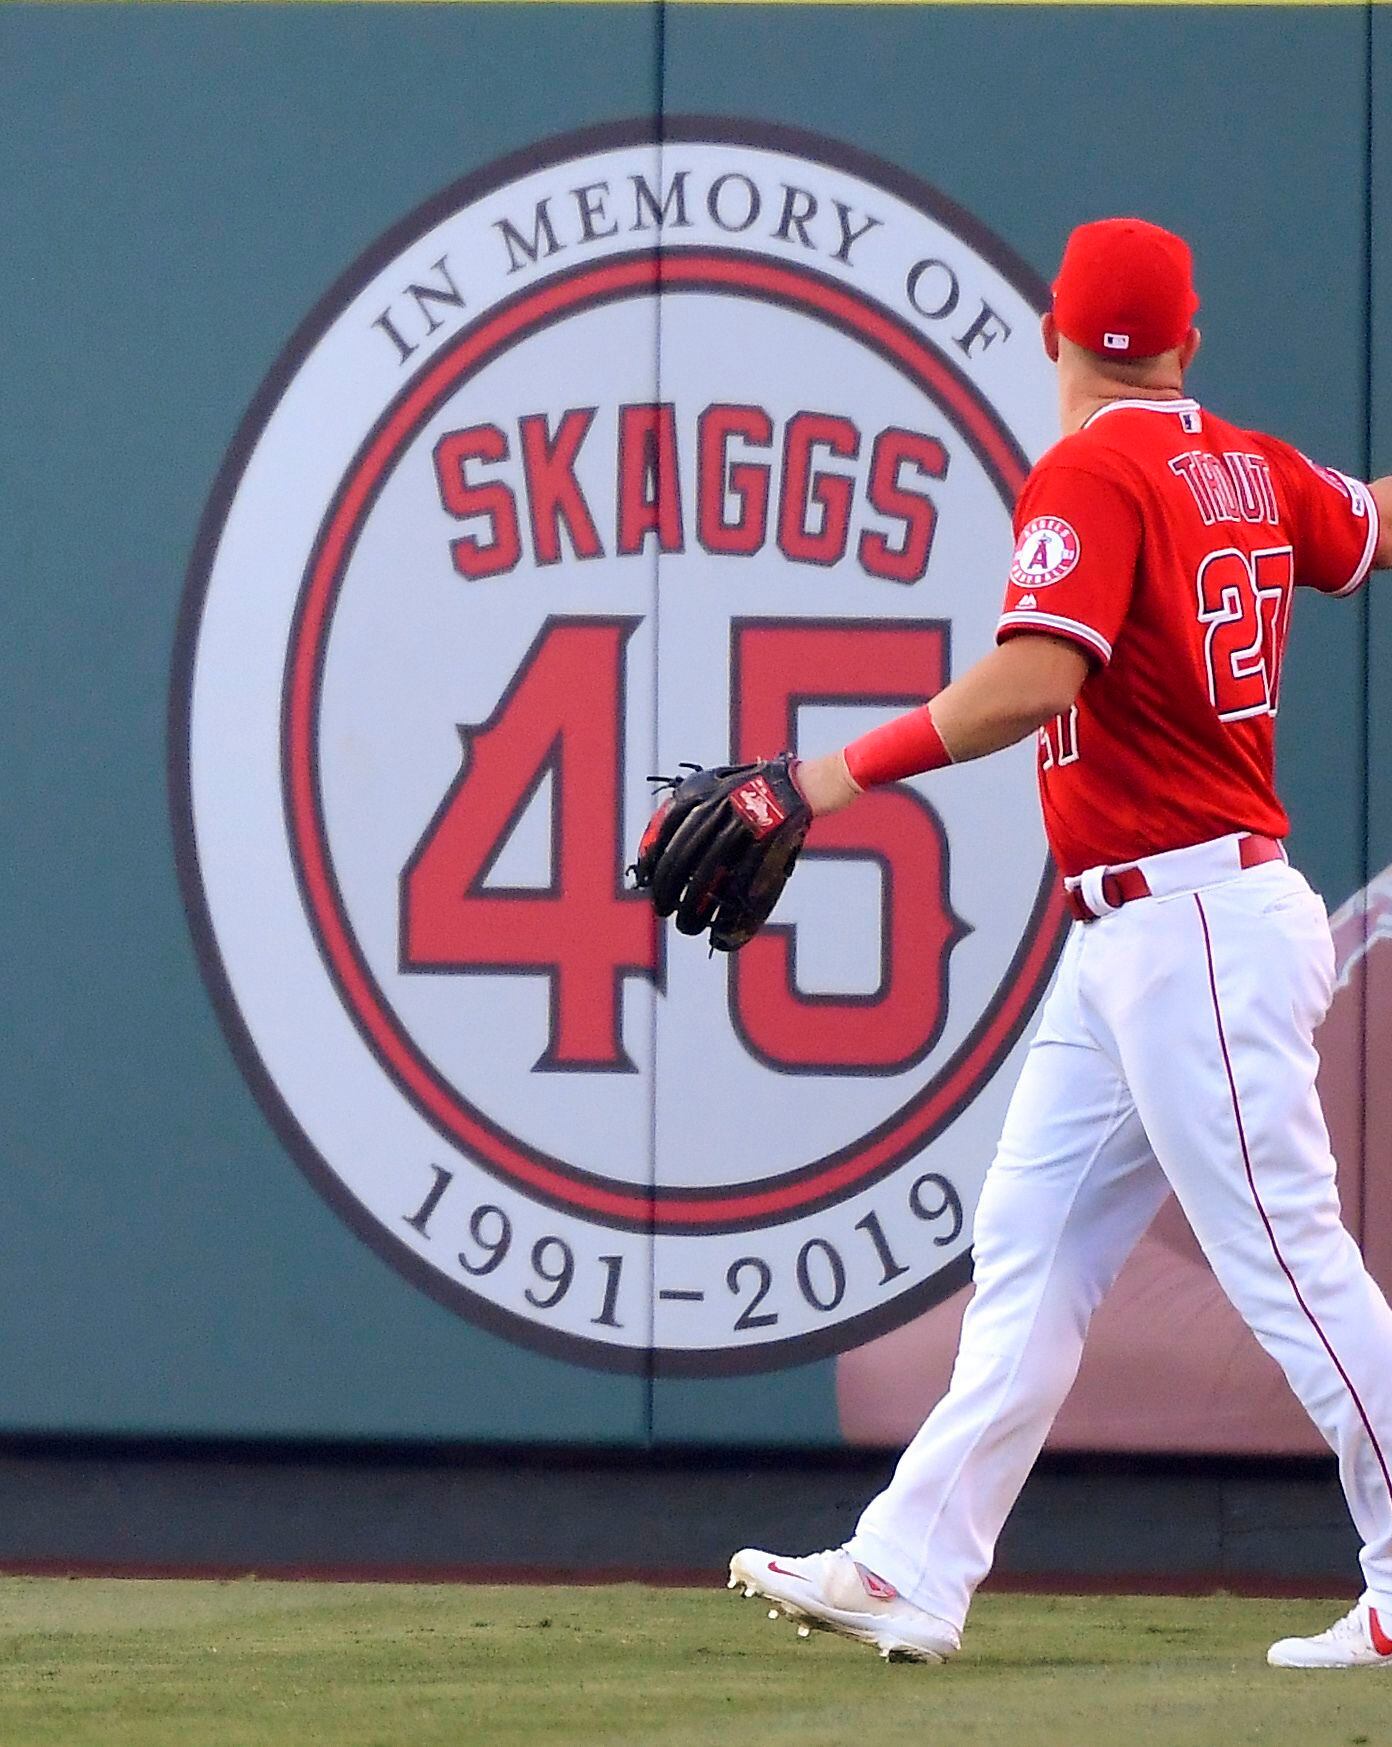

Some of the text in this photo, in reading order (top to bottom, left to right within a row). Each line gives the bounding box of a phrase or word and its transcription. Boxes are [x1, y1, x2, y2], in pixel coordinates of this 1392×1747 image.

[371, 171, 1011, 367] IN MEMORY OF
[432, 402, 950, 585] SKAGGS
[1197, 545, 1294, 723] 27
[398, 615, 975, 1079] 45
[402, 1162, 964, 1331] 1991-2019
